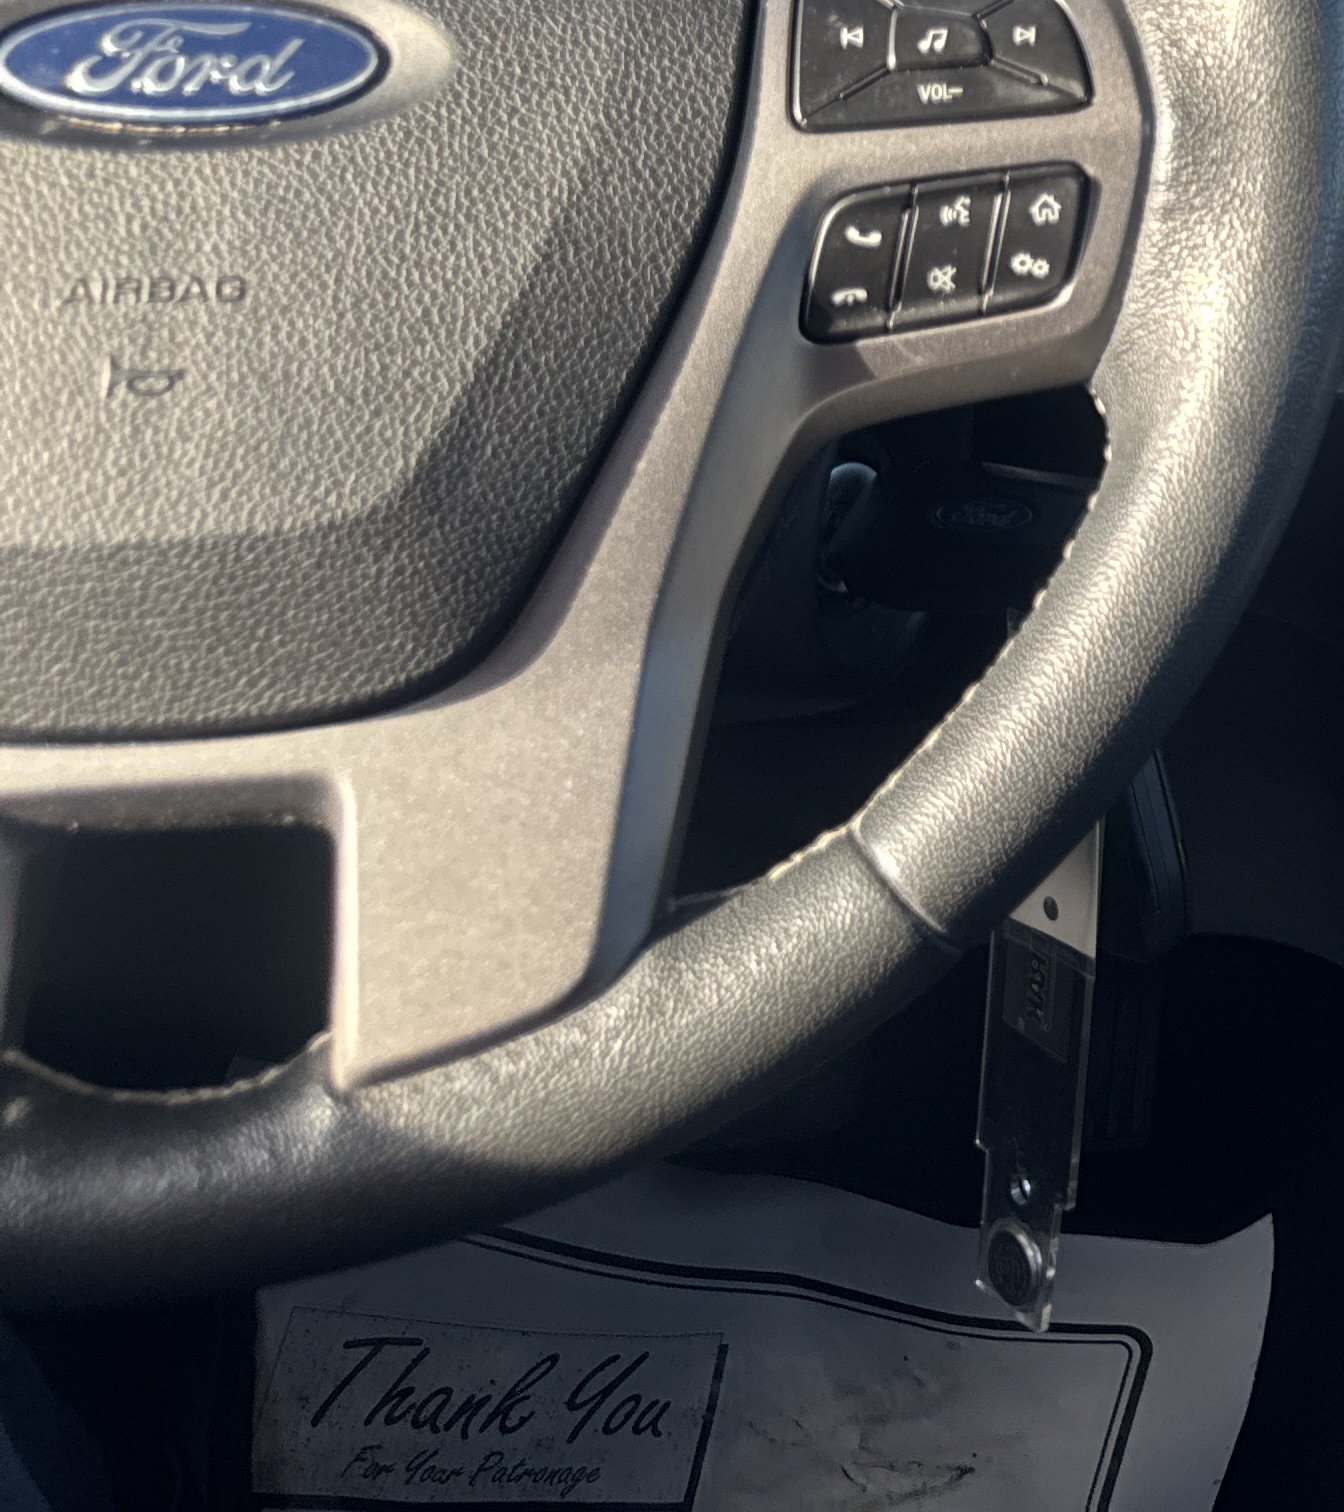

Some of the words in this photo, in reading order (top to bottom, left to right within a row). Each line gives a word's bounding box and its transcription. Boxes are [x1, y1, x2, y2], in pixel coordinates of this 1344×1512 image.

[62, 17, 305, 97] Ford
[62, 274, 248, 305] AIRBAG
[309, 1336, 561, 1441] Thank
[563, 1350, 673, 1445] You
[341, 1443, 396, 1480] For
[404, 1446, 464, 1487] Your
[468, 1449, 602, 1498] Patronage
